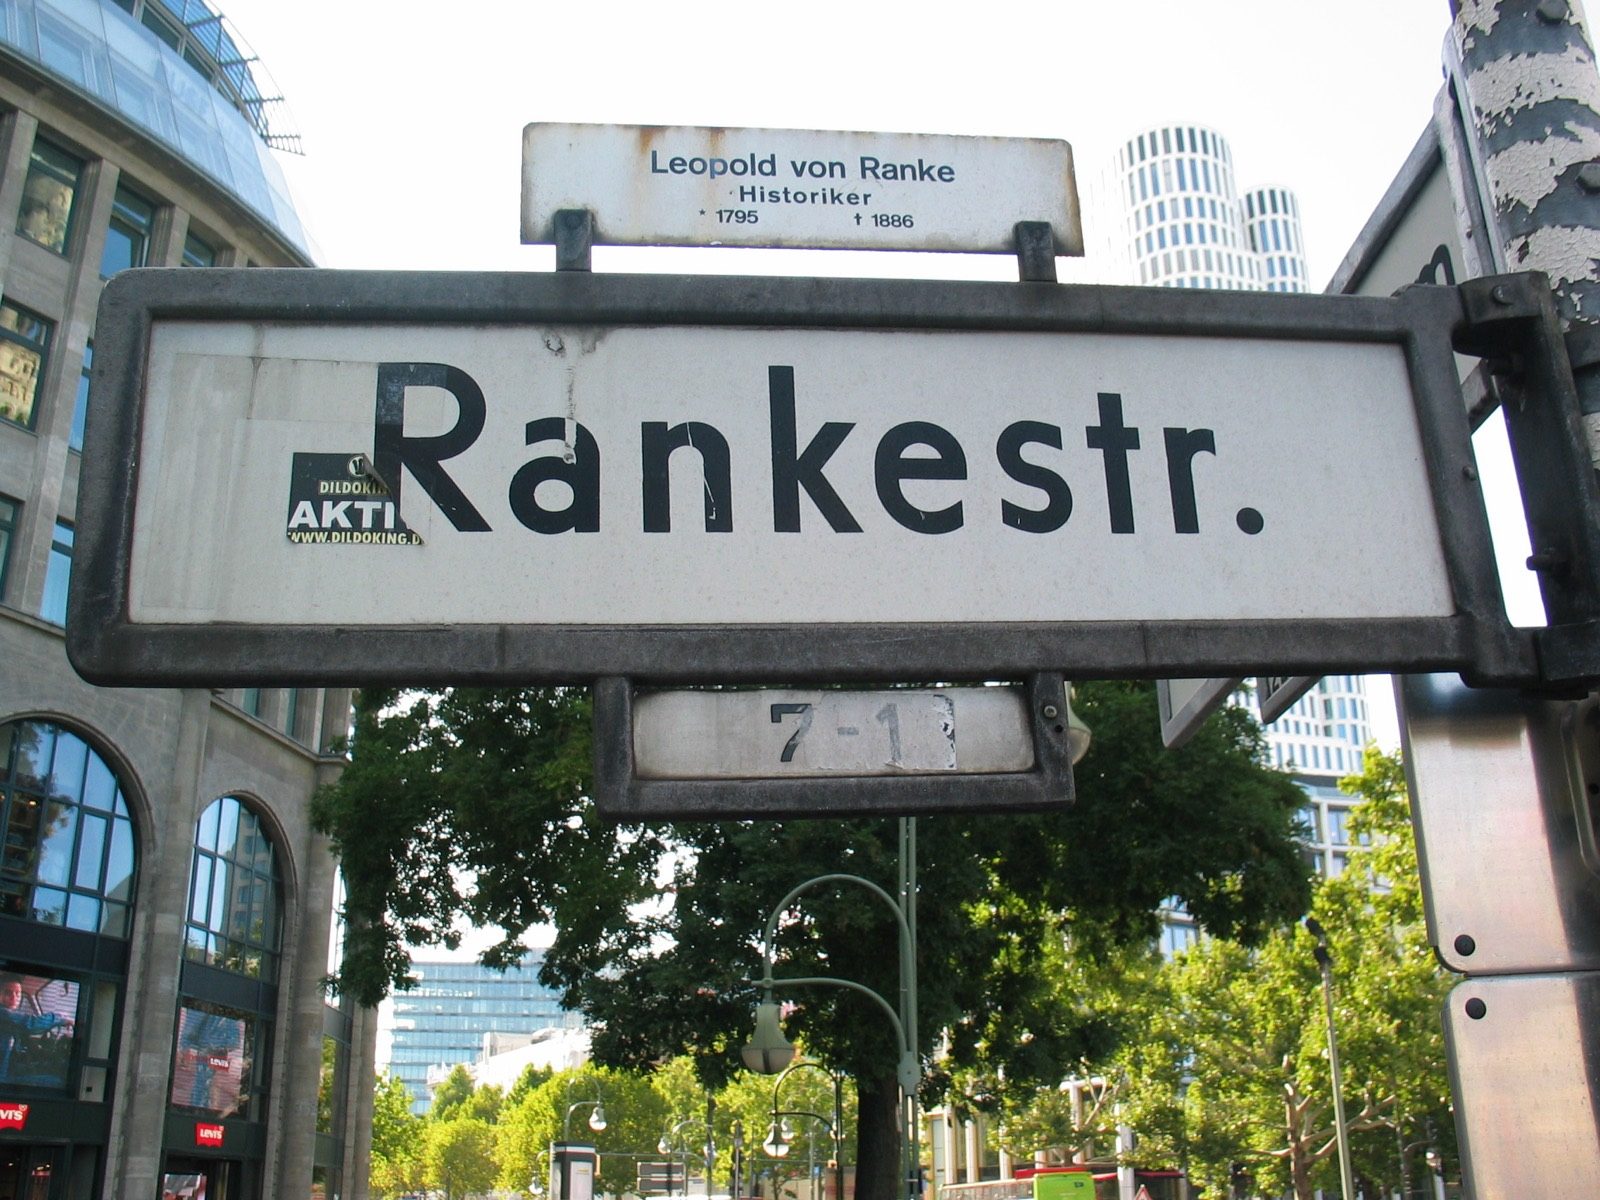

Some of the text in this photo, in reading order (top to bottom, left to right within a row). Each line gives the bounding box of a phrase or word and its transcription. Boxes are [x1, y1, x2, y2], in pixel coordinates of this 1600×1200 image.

[651, 150, 956, 183] Leopold von Ranke
[739, 185, 872, 206] Historiker
[715, 209, 759, 224] 1795
[871, 213, 914, 228] 1886
[374, 362, 1264, 535] Rankestr.
[288, 531, 423, 545] WWW.DILDOKING.D
